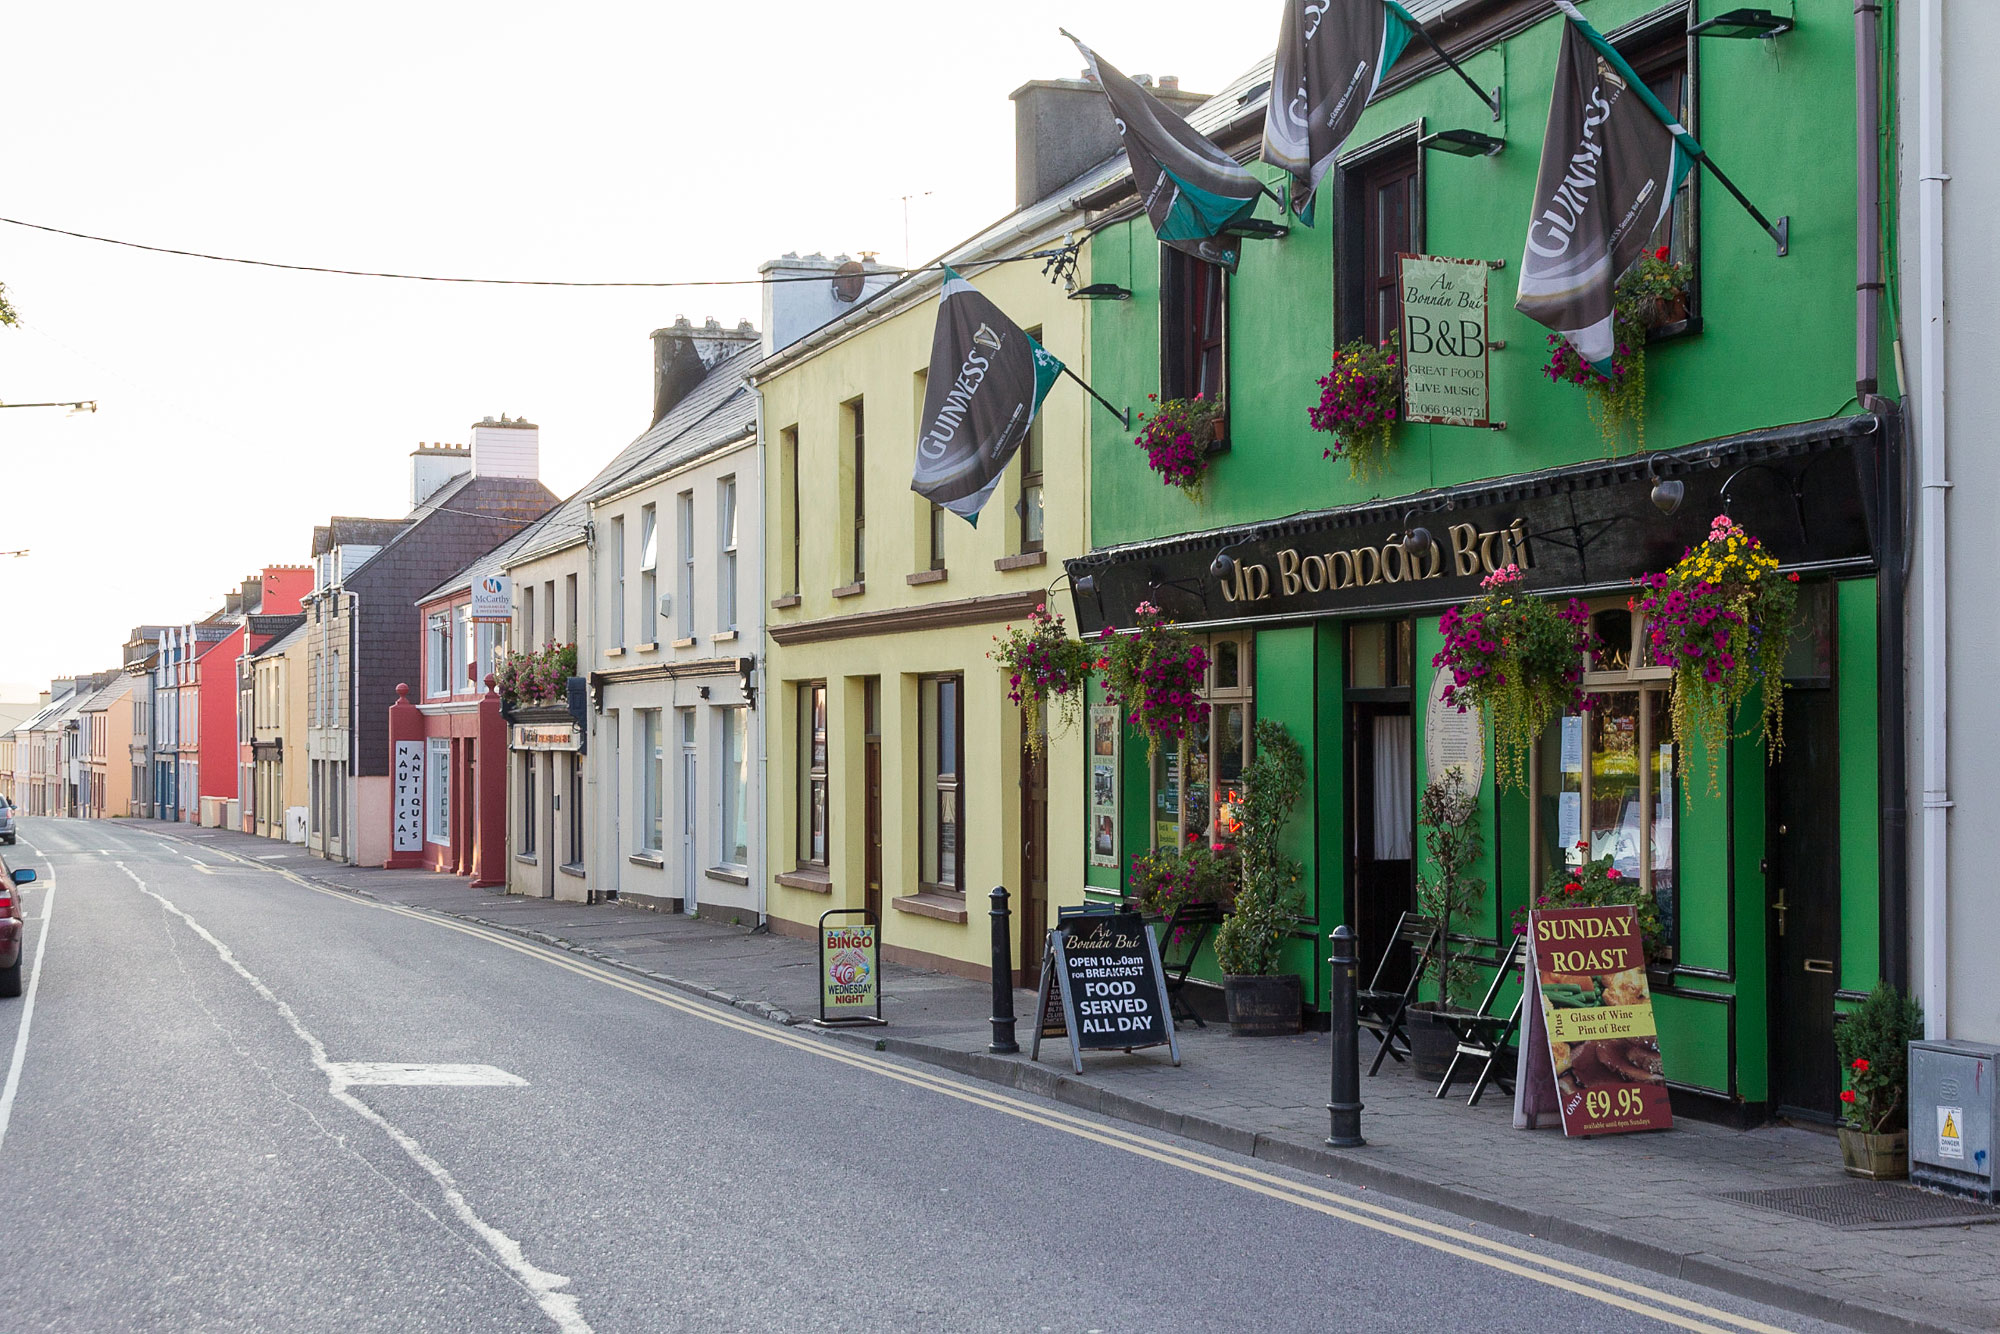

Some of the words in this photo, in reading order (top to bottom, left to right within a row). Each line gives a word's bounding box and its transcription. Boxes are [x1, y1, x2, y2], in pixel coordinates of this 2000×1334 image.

[1430, 273, 1455, 291] An
[1406, 286, 1454, 307] Bonnán
[1457, 291, 1484, 309] Buí
[1408, 316, 1484, 358] B&B
[1409, 364, 1448, 376] GREAT
[1451, 367, 1484, 379] FOOD
[1415, 382, 1440, 393] LIVE
[1443, 385, 1480, 397] MUSIC
[920, 349, 990, 460] GUINNESS
[1420, 404, 1440, 414] 066
[1442, 405, 1485, 418] 9481731
[1277, 532, 1443, 597] Bonnán
[1449, 518, 1529, 577] Buí
[475, 594, 510, 604] McCarthy
[398, 747, 408, 845] NAUTICAL
[411, 753, 420, 840] ANTIQUES
[1089, 923, 1112, 939] An
[1537, 916, 1632, 941] SUNDAY
[827, 935, 873, 949] BINGO
[1066, 935, 1113, 949] Bonnán
[1114, 934, 1140, 949] Buí
[1069, 957, 1098, 967] OPEN
[1551, 948, 1628, 973] ROAST
[1086, 966, 1144, 978] BREAKFAST
[828, 984, 872, 995] WEDNESDAY
[1085, 980, 1136, 997] FOOD
[835, 994, 865, 1004] NIGHT
[1080, 998, 1148, 1015] SERVED
[1082, 1018, 1115, 1033] ALL
[1118, 1016, 1152, 1031] DAY
[1570, 1013, 1595, 1022] Glass
[1597, 1011, 1607, 1021] of
[1609, 1010, 1633, 1020] Wine
[1555, 1013, 1564, 1037] Plus
[1577, 1025, 1597, 1035] Pint
[1598, 1023, 1608, 1033] of
[1610, 1023, 1631, 1032] Beer
[1566, 1092, 1582, 1116] ONLY
[1586, 1088, 1644, 1119] €9.95
